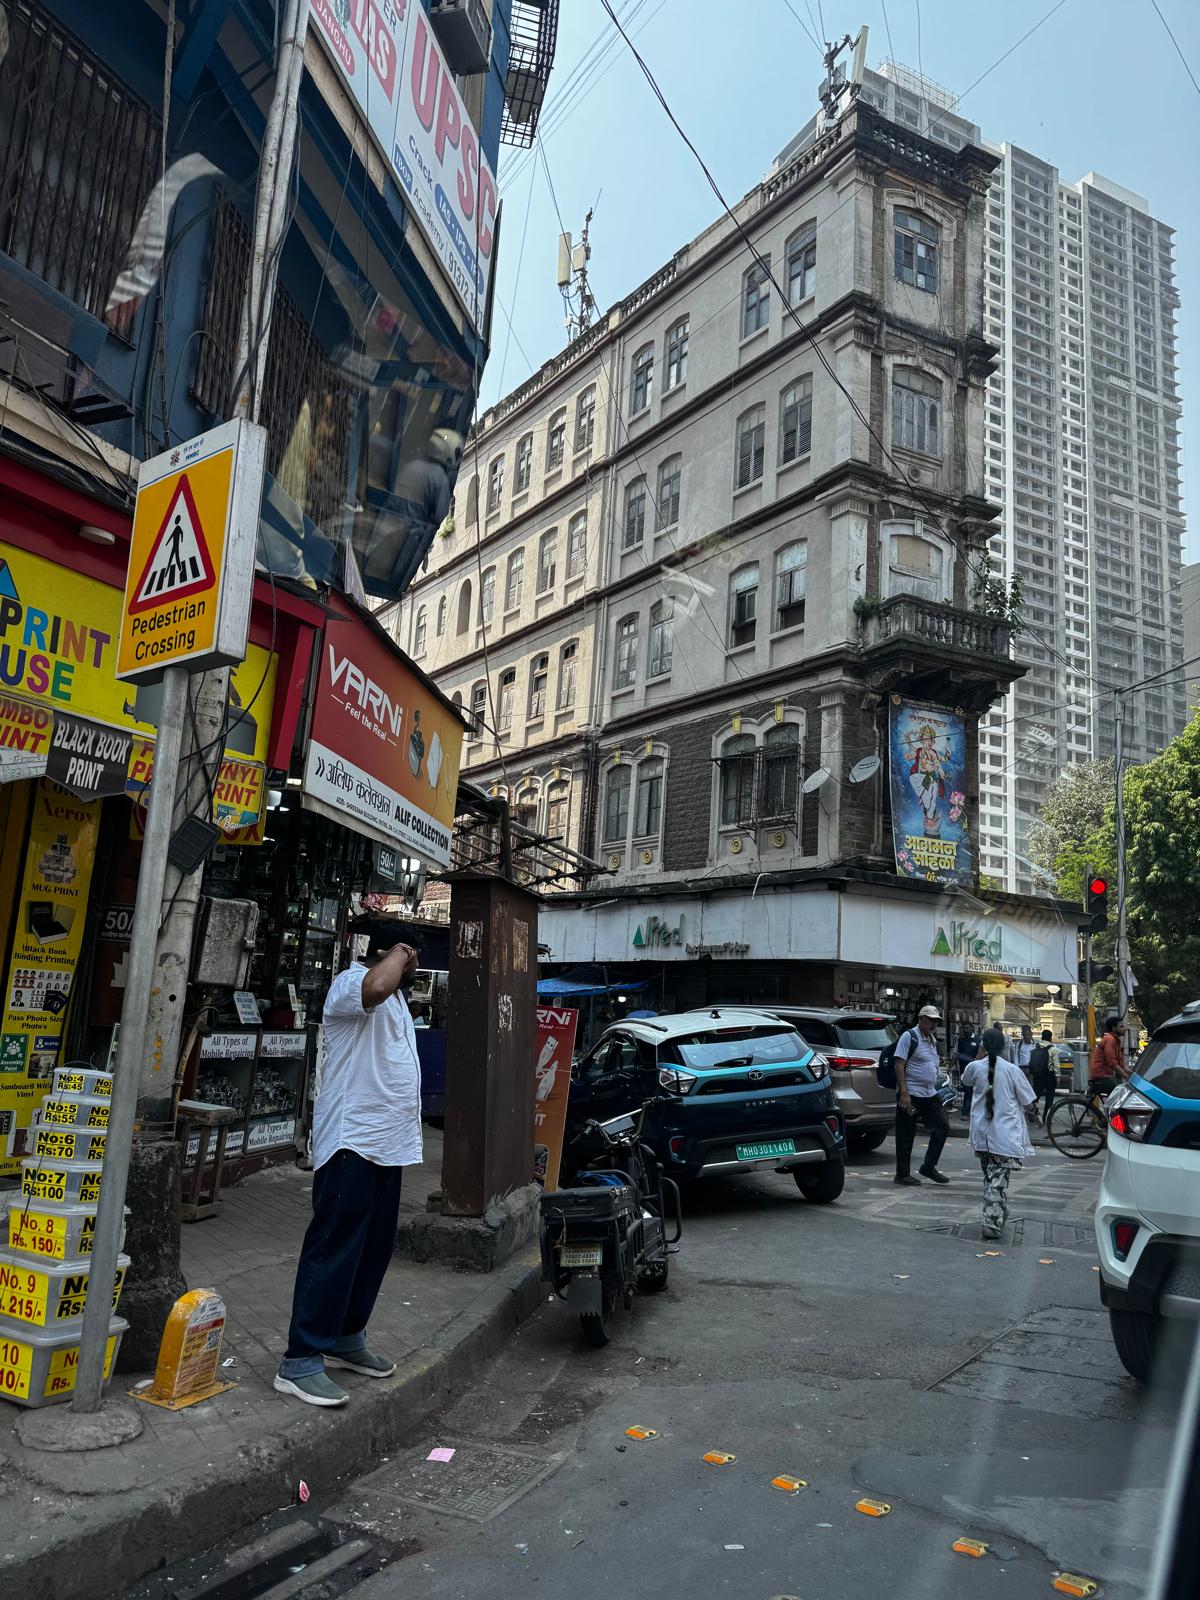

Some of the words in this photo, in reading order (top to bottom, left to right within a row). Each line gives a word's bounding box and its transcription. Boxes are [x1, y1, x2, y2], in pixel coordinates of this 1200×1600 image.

[410, 14, 496, 260] UPSC
[409, 135, 433, 191] Crack
[439, 192, 453, 221] IAS
[413, 187, 445, 253] Academy
[132, 601, 205, 638] Pedestrian
[0, 596, 110, 669] PRINT
[135, 629, 195, 661] Crossing
[0, 643, 75, 701] USE
[345, 702, 361, 720] Feel
[361, 715, 373, 730] the
[372, 724, 388, 741] Real
[53, 719, 96, 757] BLACK
[94, 731, 131, 765] BOOK
[65, 756, 105, 791] PRINT
[214, 781, 257, 807] RINT
[325, 759, 355, 793] अलिफ
[355, 778, 392, 817] कलेक्शन
[41, 797, 94, 823] Xerox
[394, 804, 413, 828] ALIF
[411, 815, 450, 852] COLLECTION
[903, 835, 958, 857] आगमन
[32, 883, 50, 893] MUG
[54, 886, 80, 897] PRINT
[103, 910, 135, 931] 50/
[930, 920, 1002, 962] Alfred
[15, 952, 43, 963] Binding
[45, 955, 76, 966] Printing
[48, 947, 67, 955] Book
[968, 962, 1017, 974] RESTAURANT
[1019, 966, 1026, 975] &
[1027, 967, 1042, 977] BAR
[8, 1014, 25, 1022] Pass
[26, 1014, 48, 1022] Photo
[21, 1022, 48, 1030] Photo's
[211, 1036, 220, 1046] All
[222, 1036, 241, 1050] Types
[241, 1036, 249, 1046] of
[270, 1036, 279, 1046] All
[280, 1036, 293, 1049] Types
[201, 1049, 222, 1058] Mobile
[224, 1050, 254, 1060] Repairing
[1, 1083, 35, 1091] Sunboard
[57, 1082, 83, 1091] Rs:45
[59, 1075, 84, 1083] No:4
[16, 1091, 34, 1099] Vinyl
[93, 1087, 112, 1096] Rs:4
[46, 1102, 77, 1113] No:5
[45, 1112, 75, 1124] Rs:55
[257, 1125, 265, 1135] All
[266, 1123, 279, 1134] Types
[279, 1120, 289, 1130] of
[38, 1132, 75, 1145] No:6
[248, 1135, 268, 1147] Mobile
[268, 1131, 295, 1145] Repairing
[36, 1144, 73, 1158] Rs:70
[743, 1142, 793, 1157] MH03DX1404
[25, 1169, 65, 1184] No:7
[23, 1183, 63, 1199] Rs:100
[21, 1213, 42, 1231] No.
[46, 1219, 55, 1234] 8
[12, 1232, 28, 1248] Rs.
[31, 1236, 61, 1256] 150/-
[0, 1266, 21, 1290] No.
[27, 1274, 36, 1293] 9
[9, 1295, 41, 1321] 215/-
[3, 1342, 20, 1366] 10
[51, 1377, 70, 1390] Rs.
